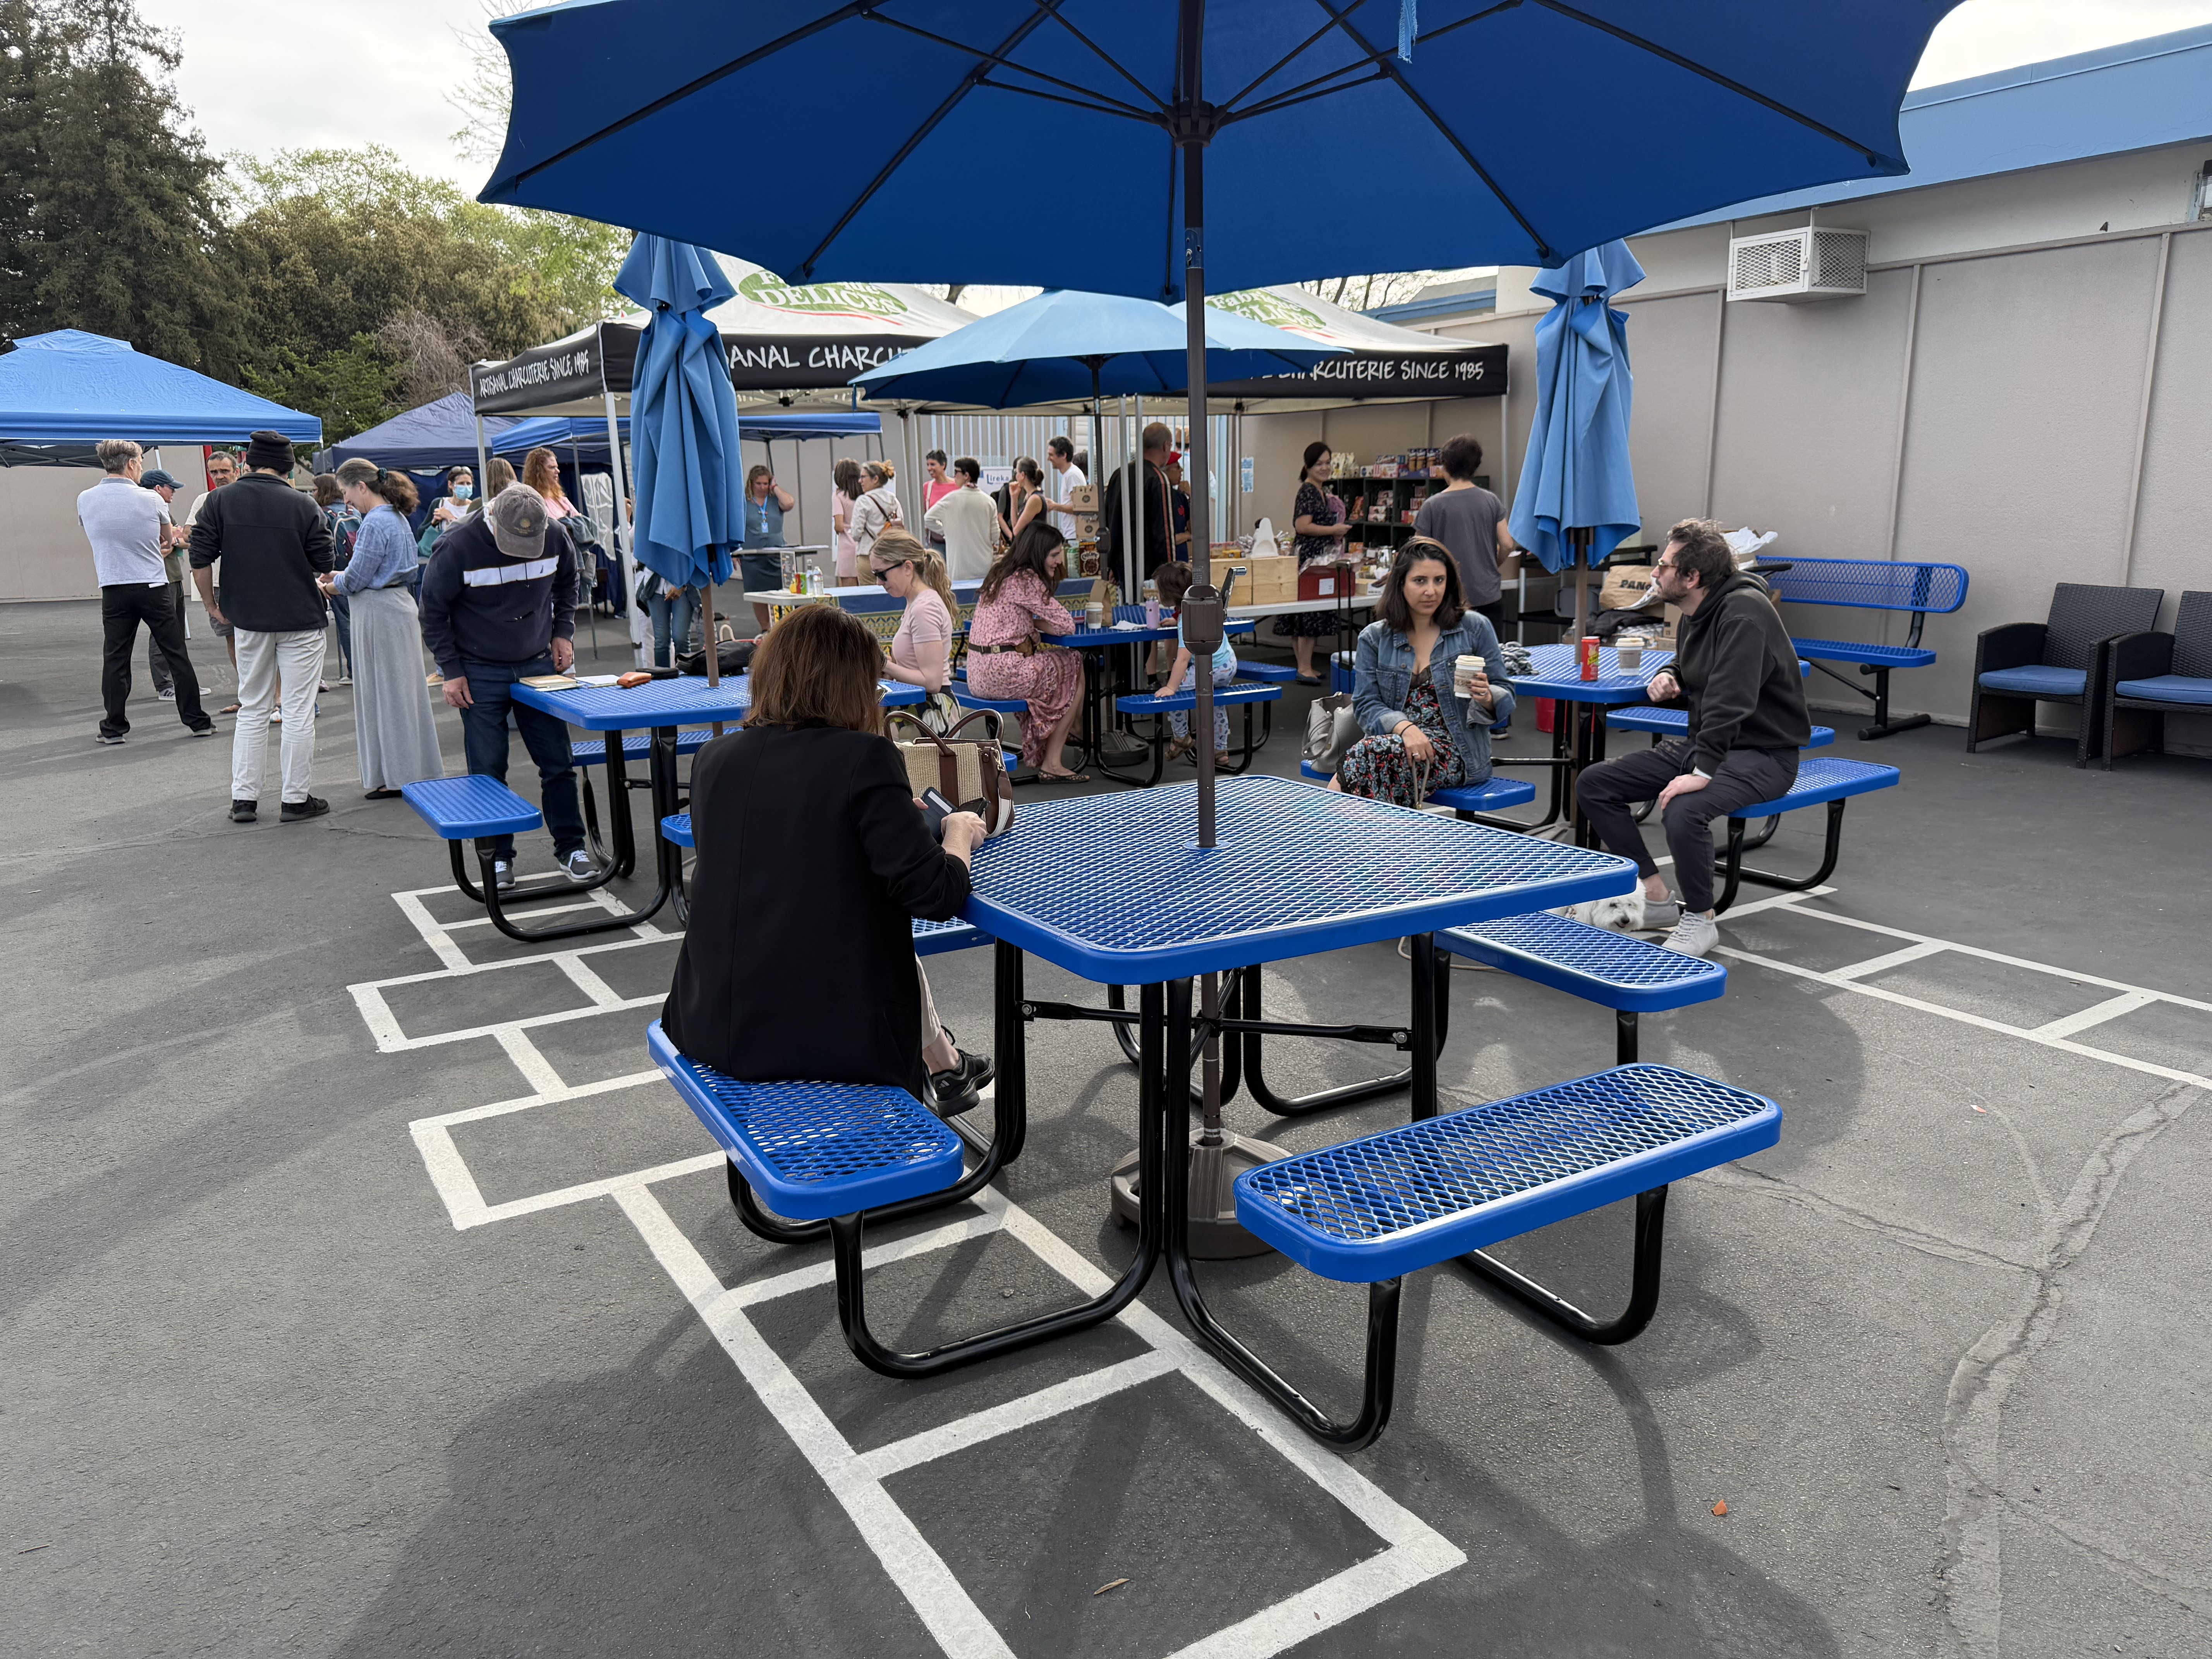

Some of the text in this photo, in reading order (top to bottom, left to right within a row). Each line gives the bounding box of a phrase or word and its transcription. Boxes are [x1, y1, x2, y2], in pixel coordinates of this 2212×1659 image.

[753, 286, 902, 313] DELICES
[1231, 305, 1324, 328] ELICES
[726, 344, 800, 369] ANAL
[479, 349, 589, 398] ARTISANAL CHARCUTERIE SINCE 1985
[1279, 359, 1484, 381] RCUTERIE SINCE 1985
[987, 474, 1009, 484] Lireka
